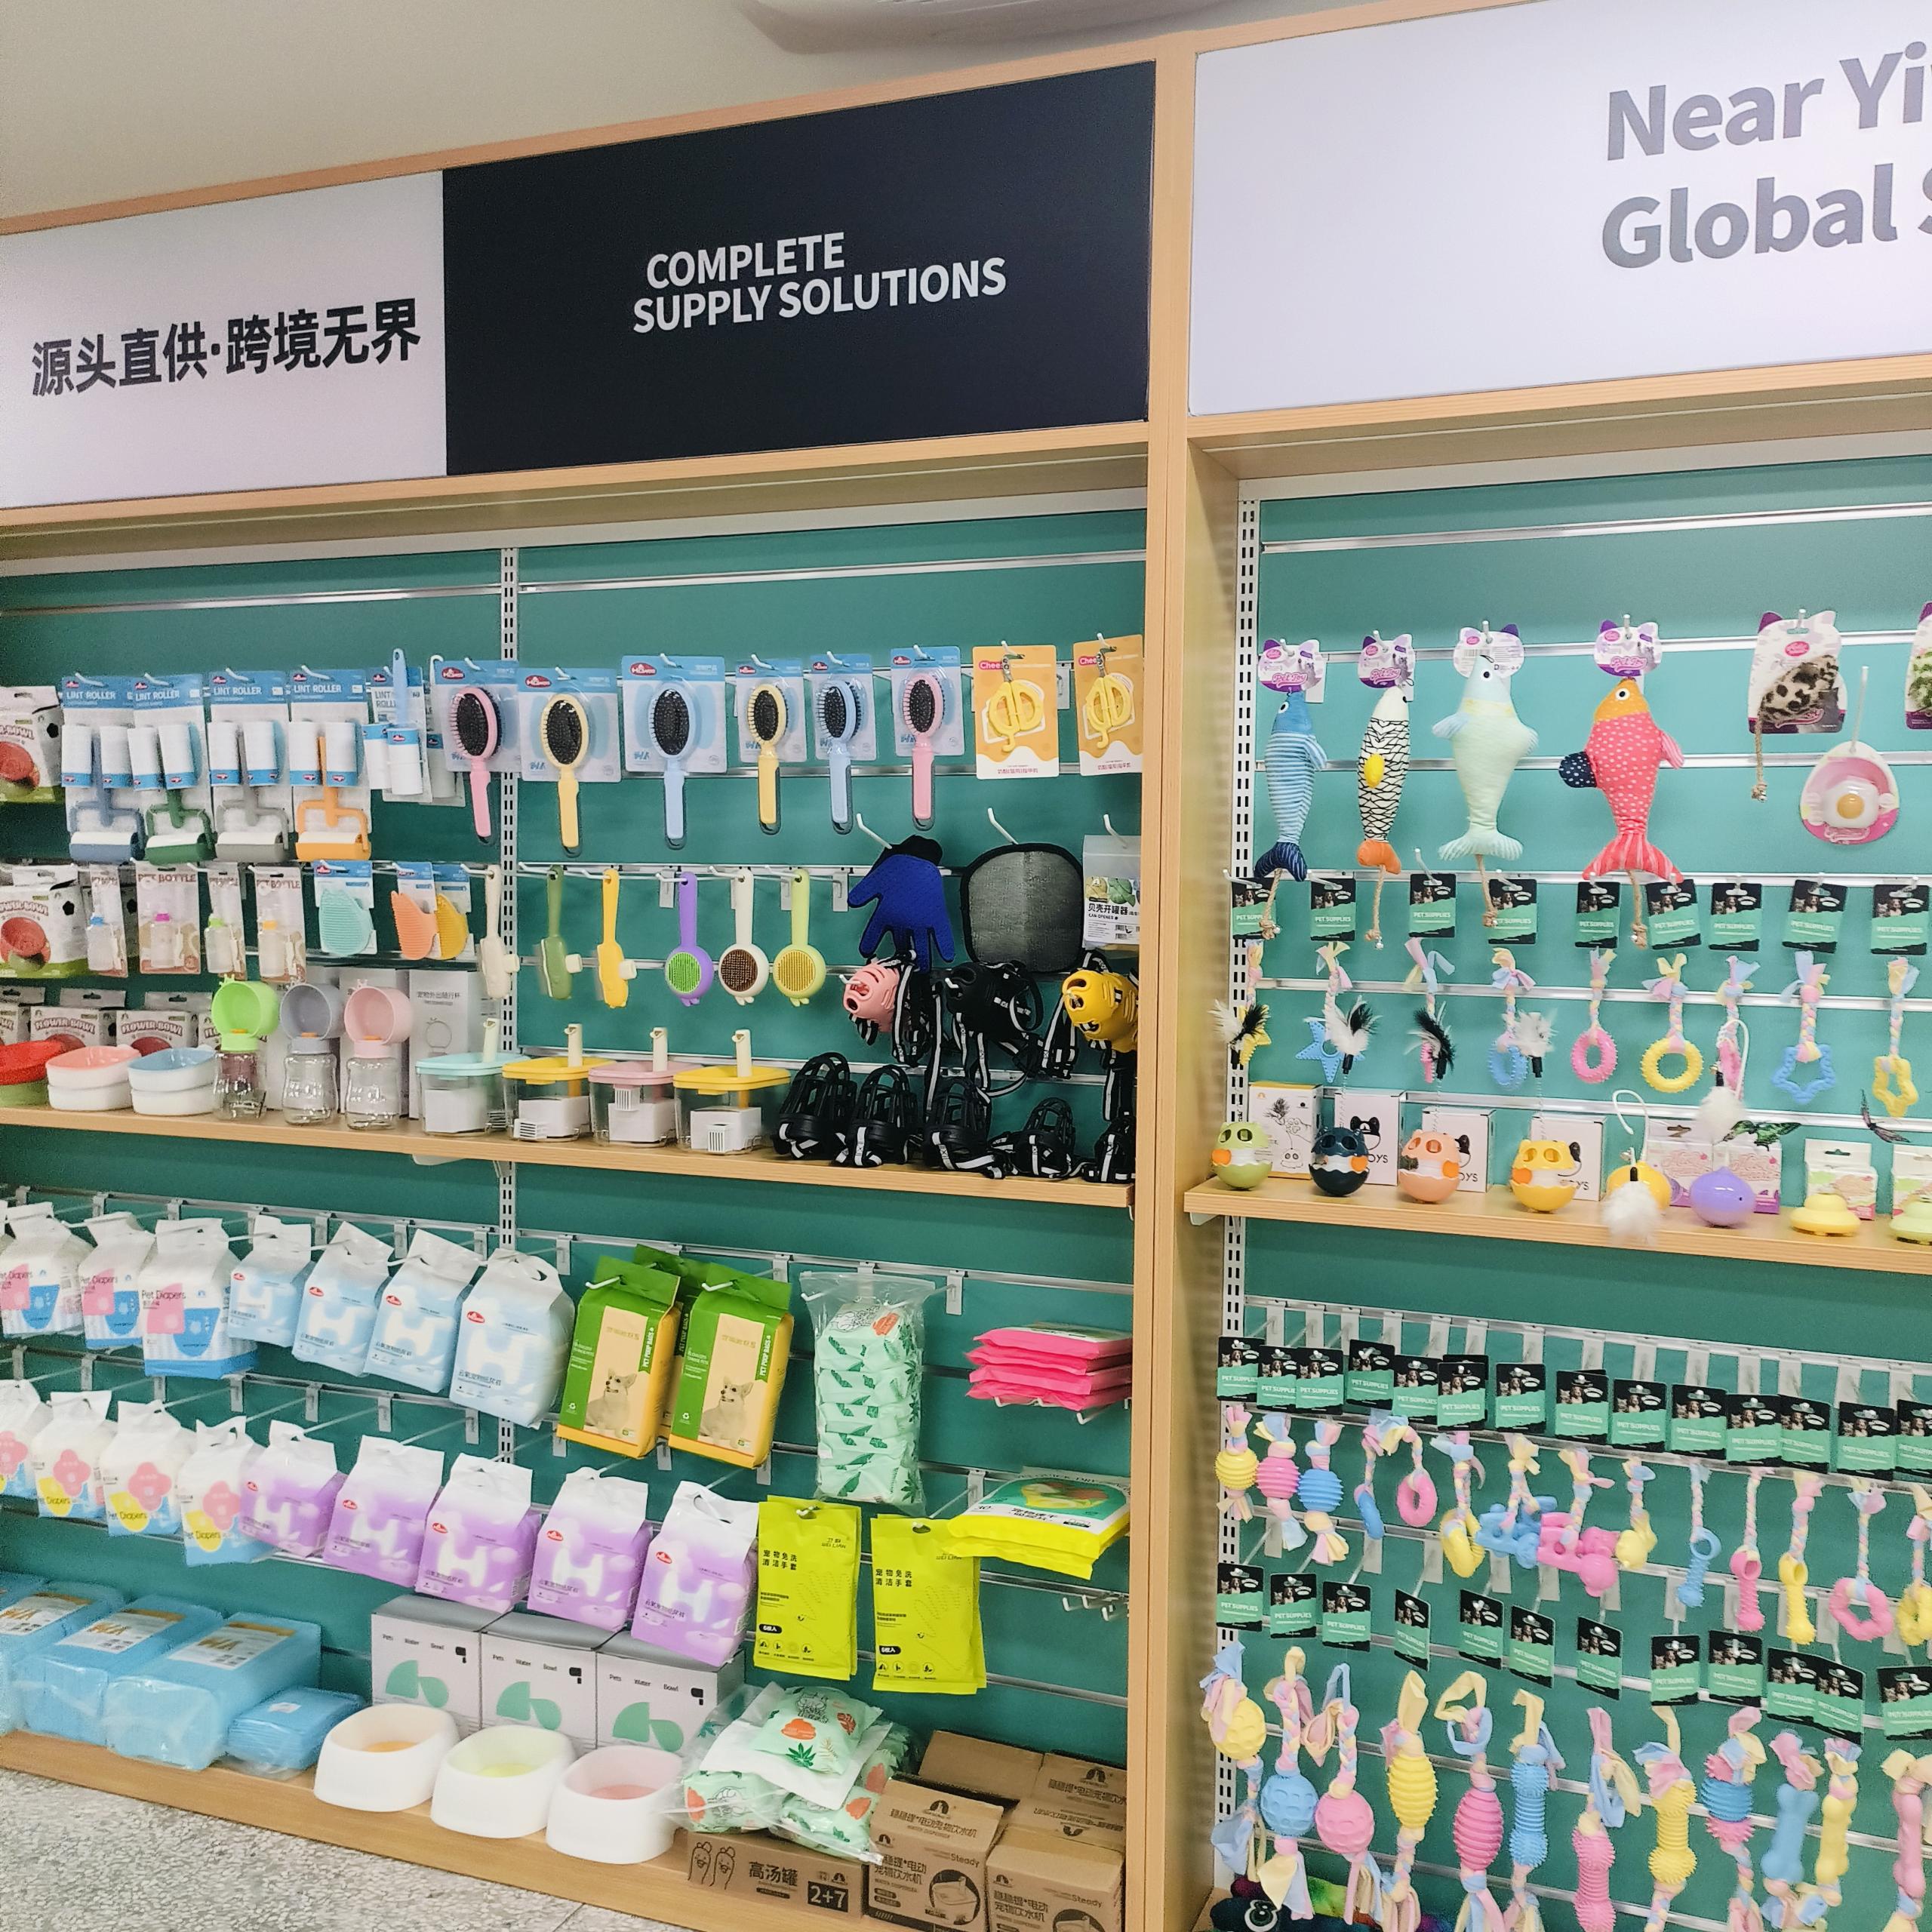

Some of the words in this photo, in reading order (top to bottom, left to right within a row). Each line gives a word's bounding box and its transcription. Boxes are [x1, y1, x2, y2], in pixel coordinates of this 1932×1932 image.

[1607, 78, 1825, 161] Near
[1839, 41, 1932, 129] Yi
[1602, 162, 1898, 269] Global
[647, 232, 844, 288] COMPLETE
[633, 285, 772, 333] SUPPLY
[779, 257, 1006, 318] SOLUTIONS
[32, 297, 421, 396] 源头直供·跨境无界
[153, 691, 180, 700] ROLLER
[232, 687, 262, 695] ROLLER
[312, 685, 342, 693] ROLLER
[158, 874, 196, 882] BOTTLE
[1088, 903, 1128, 915] 贝壳开罐器
[35, 1018, 69, 1030] FLOWER
[70, 1019, 96, 1035] BOWL
[122, 1021, 155, 1034] FLOWER
[157, 1022, 184, 1037] BOWL
[1367, 1153, 1388, 1164] OYS
[91, 1275, 118, 1285] Diapers
[142, 1290, 154, 1299] Pet
[155, 1289, 186, 1301] Diapers
[763, 1340, 771, 1353] BAGS
[761, 1352, 769, 1367] POOP
[1363, 1380, 1389, 1390] SUPPLIES
[119, 1510, 148, 1521] Diapers
[195, 1531, 221, 1541] Diapers
[763, 1549, 797, 1562] 宠物免洗
[762, 1558, 797, 1571] 清洁手套
[875, 1568, 912, 1578] 宠物免洗
[875, 1578, 912, 1587] 清洁手套
[1232, 1603, 1258, 1612] SUPPLIES
[1339, 1623, 1365, 1632] SUPPLIES
[382, 1633, 394, 1641] Pets
[405, 1638, 420, 1647] Water
[430, 1643, 445, 1651] Bowl
[492, 1654, 504, 1662] Pets
[515, 1658, 531, 1667] Water
[543, 1663, 558, 1672] Bowl
[609, 1674, 622, 1682] Pets
[634, 1678, 651, 1688] Water
[663, 1684, 678, 1693] Bowl
[950, 1853, 980, 1868] Steady
[748, 1860, 798, 1887] 高汤罐
[810, 1886, 848, 1909] 2+7
[1072, 1894, 1103, 1909] Steady
